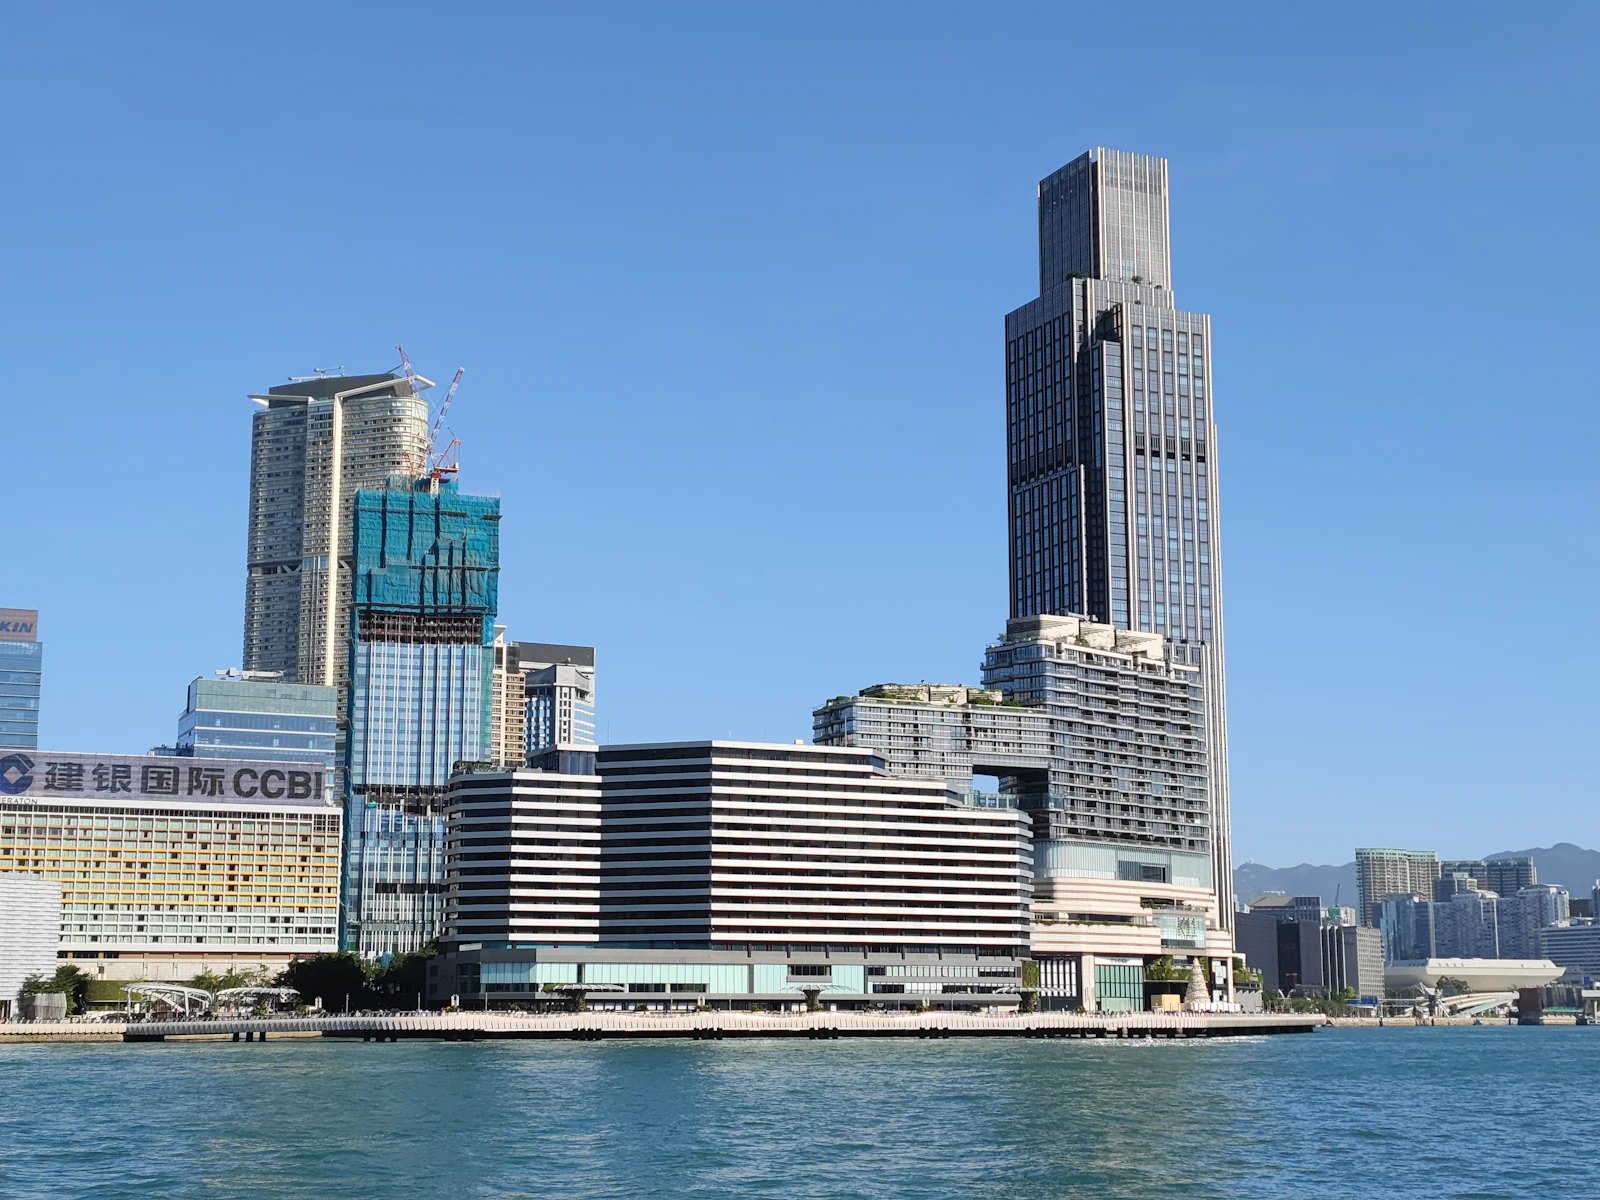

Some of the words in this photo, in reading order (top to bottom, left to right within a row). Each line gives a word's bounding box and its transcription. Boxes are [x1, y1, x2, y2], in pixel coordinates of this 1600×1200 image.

[44, 761, 225, 796] 建银国际
[233, 768, 322, 799] CCBI
[1177, 917, 1198, 937] K11
